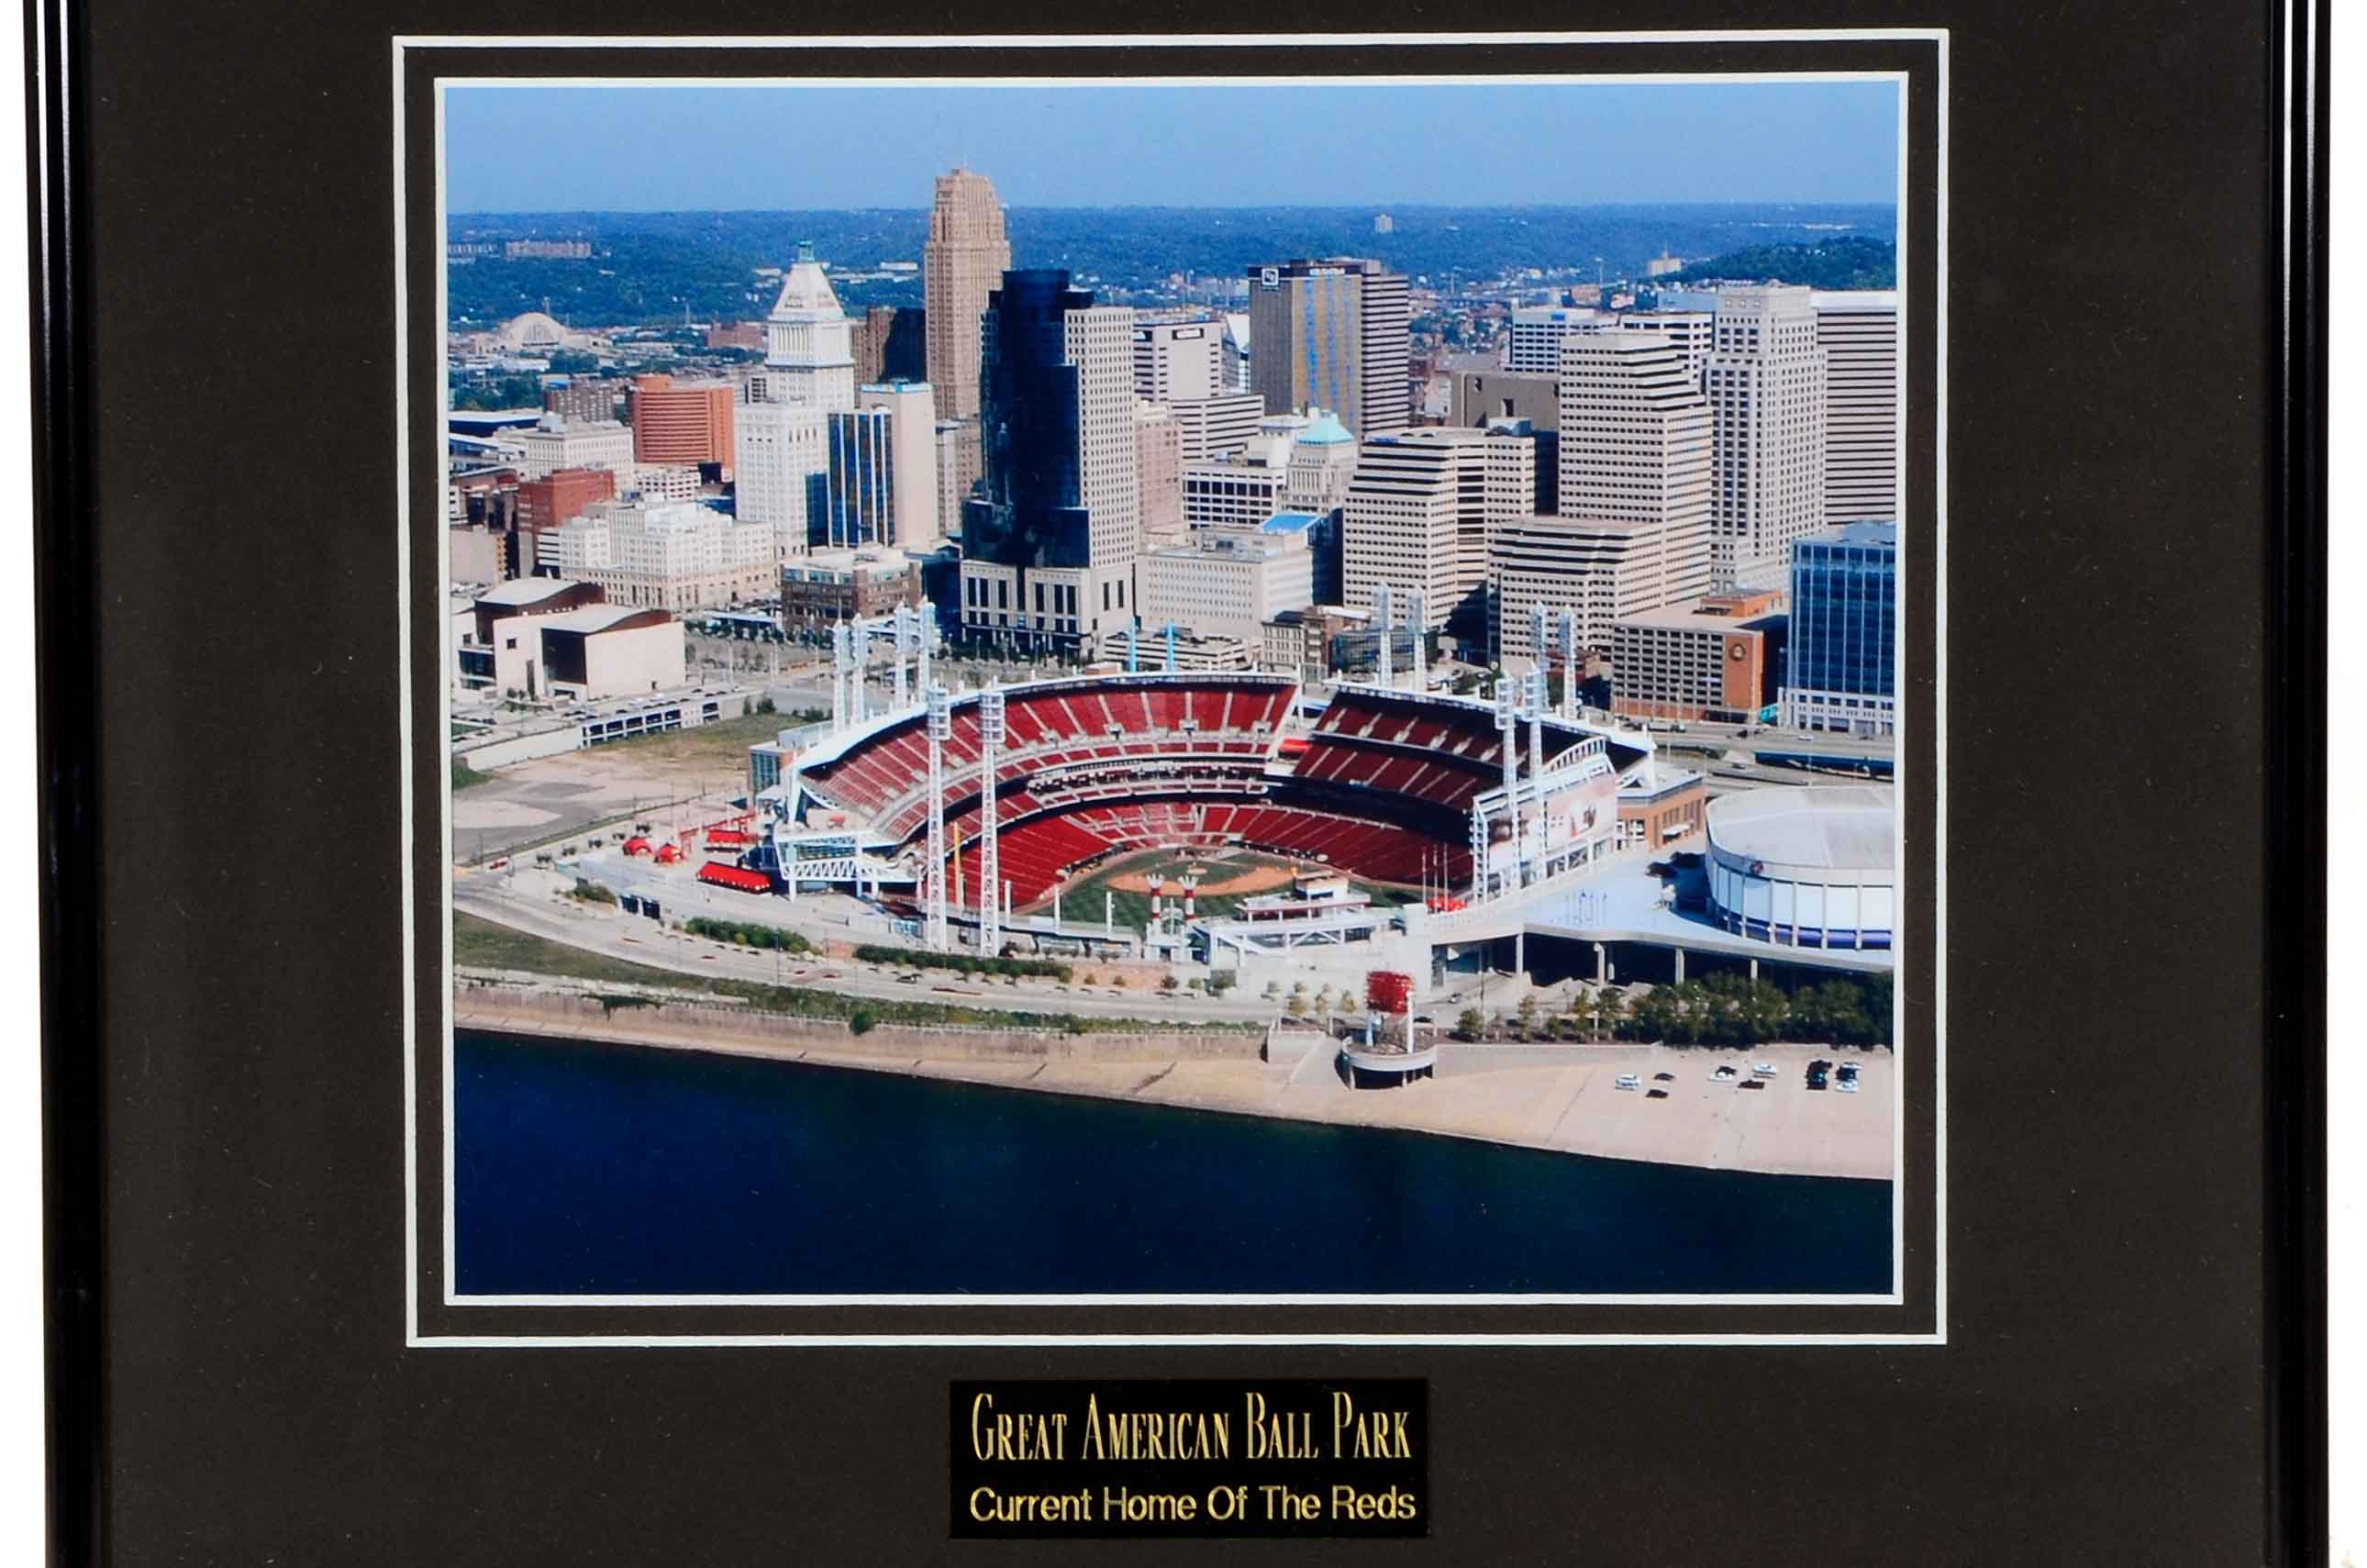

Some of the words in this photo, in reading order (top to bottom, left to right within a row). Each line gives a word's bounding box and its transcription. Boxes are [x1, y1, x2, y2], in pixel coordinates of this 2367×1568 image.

[970, 1486, 1093, 1522] Current
[1103, 1486, 1197, 1521] Home
[1206, 1485, 1249, 1520] Of
[1259, 1485, 1322, 1520] The
[1331, 1485, 1417, 1520] Reds
